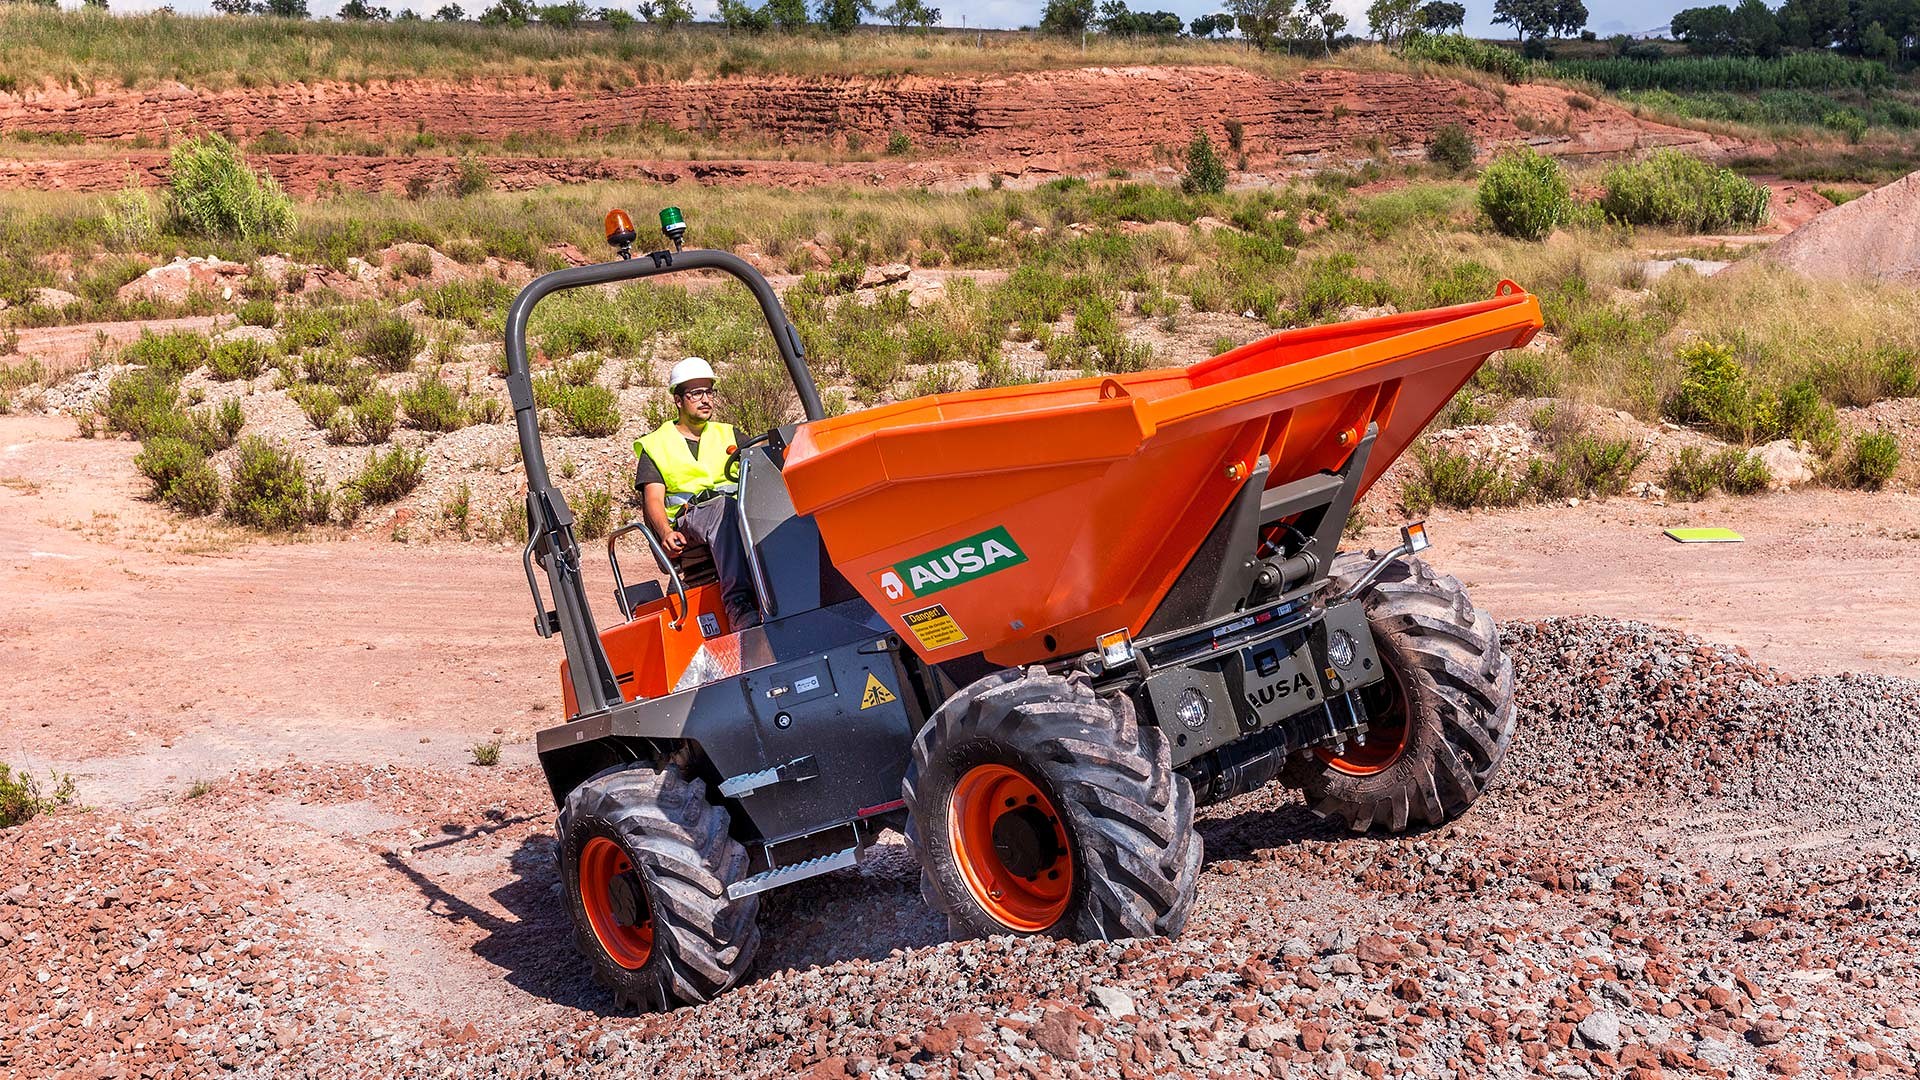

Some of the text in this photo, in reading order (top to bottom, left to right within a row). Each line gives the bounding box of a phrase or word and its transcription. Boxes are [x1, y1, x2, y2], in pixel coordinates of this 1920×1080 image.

[909, 539, 1017, 590] AUSA
[908, 607, 941, 623] Danger!
[1247, 672, 1313, 709] AUSA
